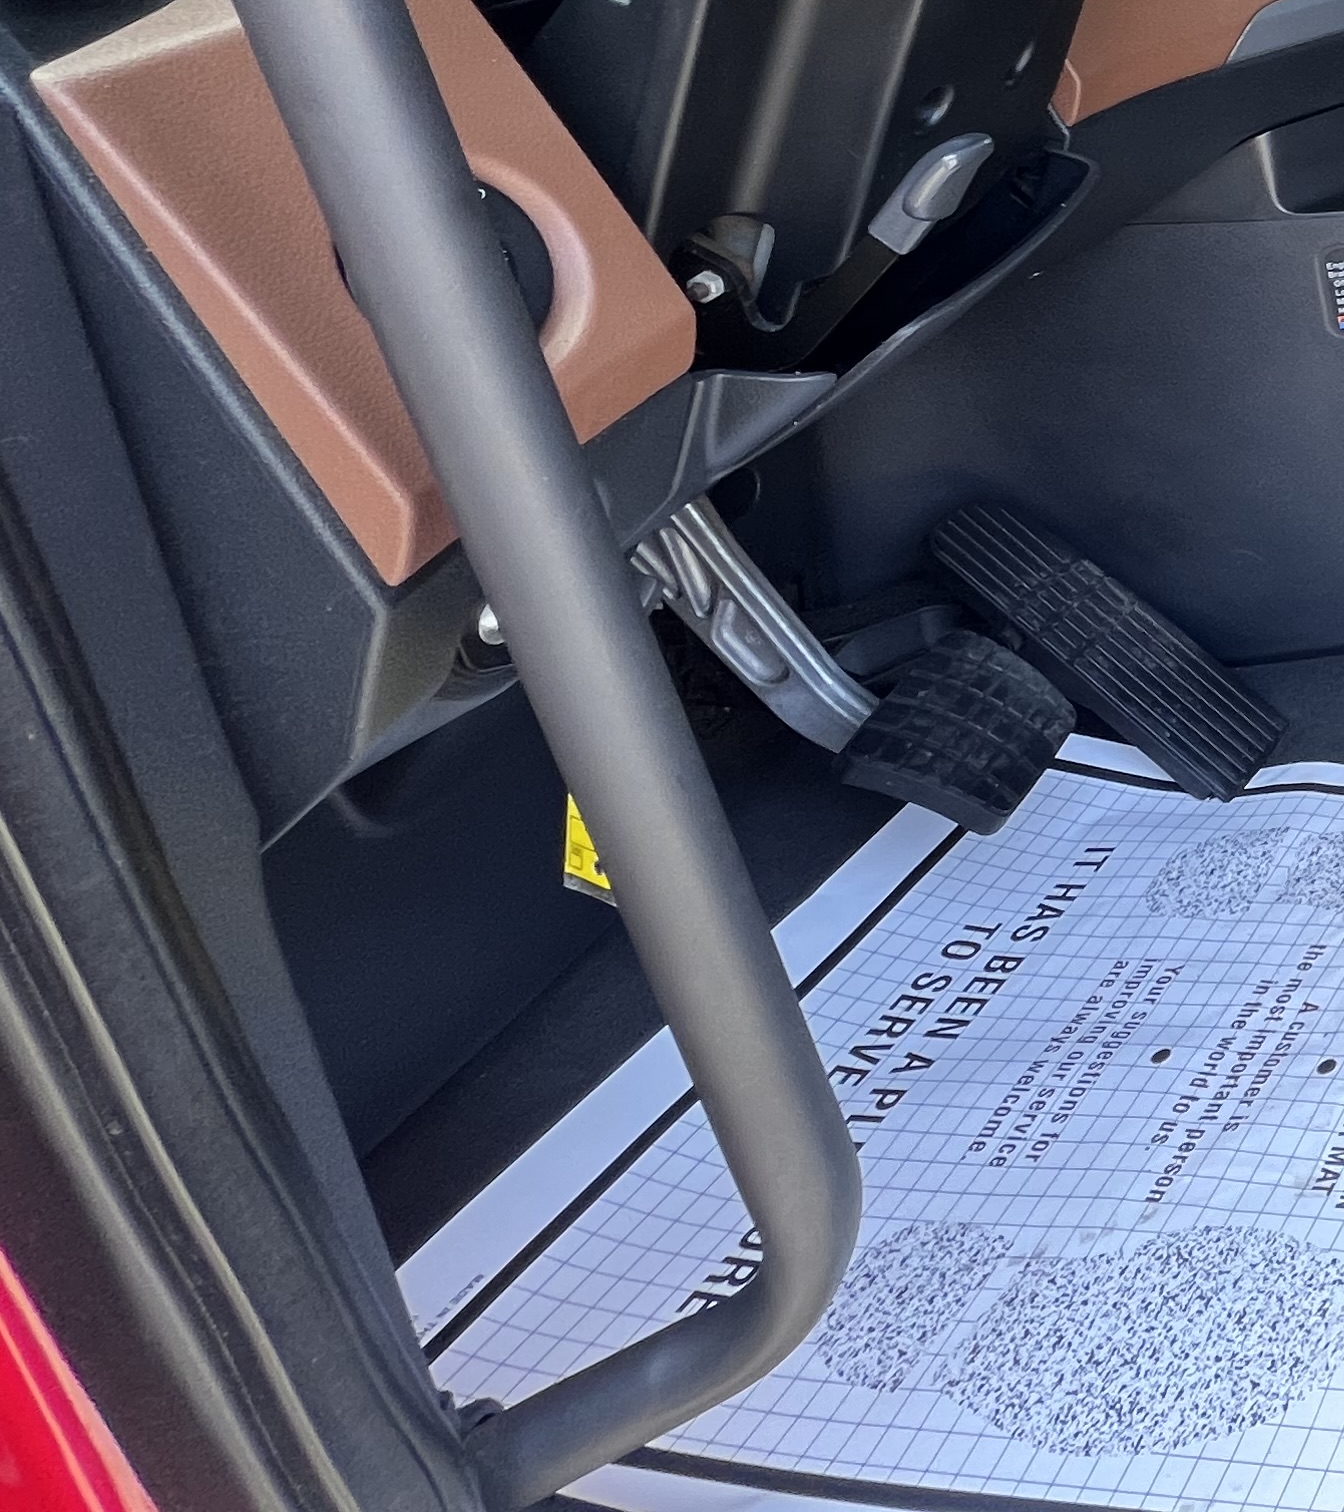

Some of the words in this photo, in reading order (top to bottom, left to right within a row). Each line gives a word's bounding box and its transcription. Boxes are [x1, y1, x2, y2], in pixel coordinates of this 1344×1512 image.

[1073, 846, 1117, 873] IT
[1010, 883, 1088, 943] HAS
[941, 922, 1003, 960] TO
[1296, 944, 1327, 972] the
[1099, 960, 1129, 988] are
[1143, 963, 1186, 1005] Your
[1252, 979, 1278, 996] in
[923, 954, 1026, 1040] BEEN
[1077, 958, 1161, 1044] improving
[1231, 1001, 1262, 1029] the
[1264, 978, 1303, 1022] most
[1300, 1001, 1320, 1015] A
[827, 972, 951, 1088] SERVE
[1043, 994, 1104, 1053] always
[889, 1051, 937, 1074] A
[1051, 1050, 1085, 1081] our
[1051, 1011, 1147, 1124] suggestions
[1189, 1036, 1236, 1090] world
[1200, 1029, 1275, 1121] important
[1242, 1022, 1305, 1107] customer
[1172, 1095, 1199, 1114] to
[1222, 1114, 1249, 1132] is
[988, 1087, 1056, 1168] service
[1025, 1132, 1060, 1163] for
[1145, 1128, 1206, 1203] person
